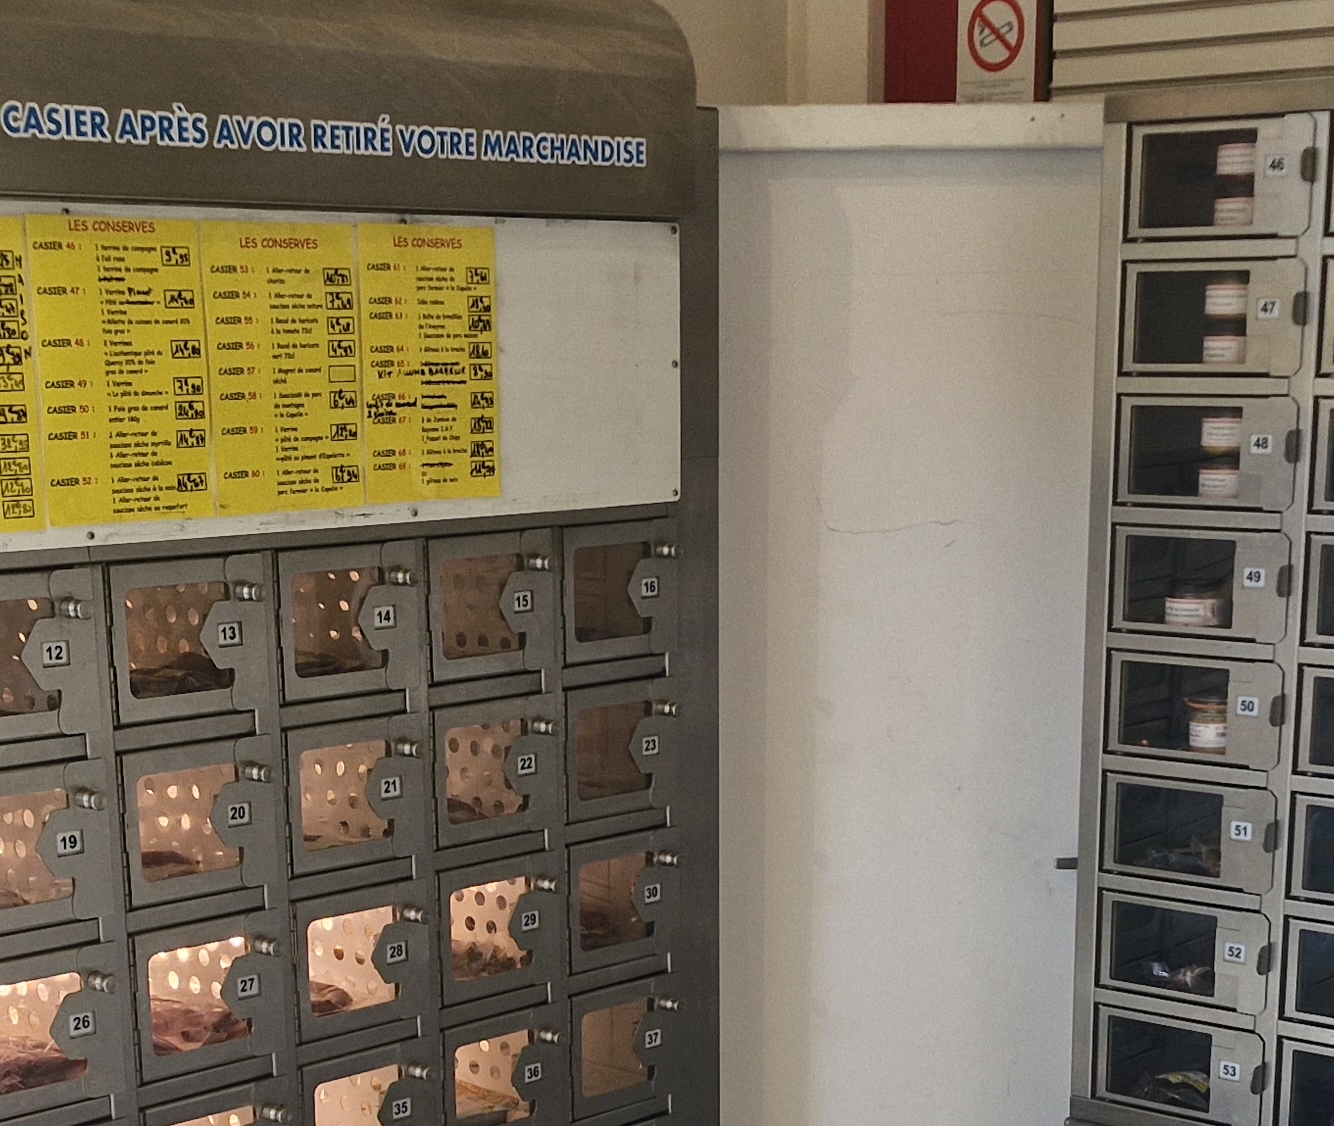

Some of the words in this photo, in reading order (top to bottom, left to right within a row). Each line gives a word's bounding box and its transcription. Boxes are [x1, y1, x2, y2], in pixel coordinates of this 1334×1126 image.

[1, 101, 110, 142] CASIER
[117, 104, 207, 146] APRÈS
[215, 113, 305, 150] AVOIR
[312, 115, 393, 155] RETIRÉ
[398, 124, 476, 159] VOTRE
[482, 130, 647, 166] MARCHANDISE
[1269, 158, 1284, 170] 46
[69, 220, 88, 231] LES
[93, 221, 155, 233] CONSERVES
[33, 241, 63, 250] CASIER
[66, 242, 75, 250] 46
[240, 237, 257, 248] LES
[262, 238, 317, 249] CONSERVES
[393, 237, 408, 247] LES
[412, 238, 462, 249] CONSERVES
[1261, 302, 1276, 313] 47
[1254, 437, 1268, 449] 48
[1246, 570, 1261, 584] 49
[644, 581, 655, 593] 16
[515, 595, 529, 609] 15
[377, 611, 391, 624] 14
[221, 626, 236, 640] 13
[46, 646, 63, 660] 12
[1240, 699, 1255, 713] 50
[645, 739, 656, 752] 23
[519, 757, 534, 769] 22
[382, 780, 399, 793] 21
[230, 806, 245, 820] 20
[1234, 825, 1248, 837] 51
[61, 835, 77, 850] 19
[646, 887, 658, 900] 30
[524, 913, 536, 926] 29
[389, 945, 405, 958] 28
[1228, 946, 1241, 958] 52
[240, 978, 255, 991] 27
[73, 1015, 90, 1030] 26
[647, 1032, 658, 1044] 37
[527, 1066, 539, 1079] 36
[1222, 1065, 1237, 1077] 53
[394, 1102, 408, 1115] 35
